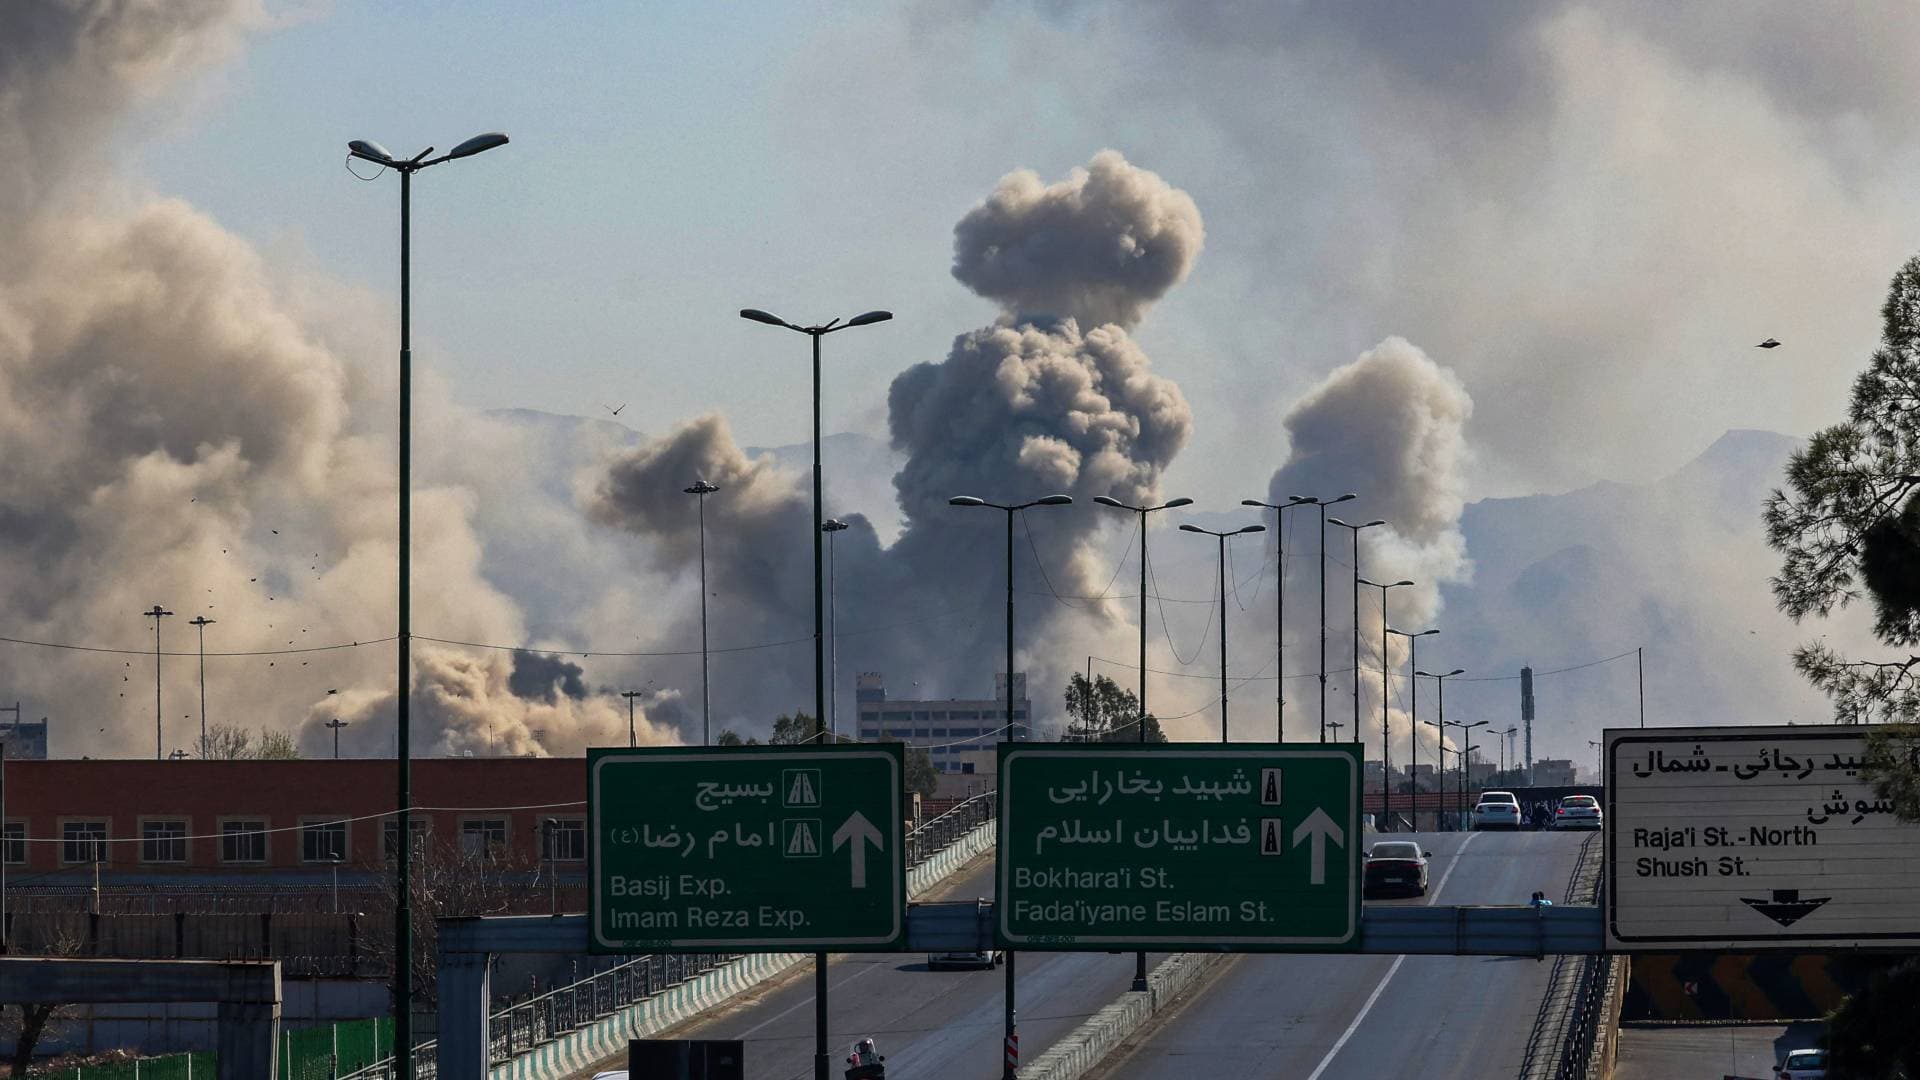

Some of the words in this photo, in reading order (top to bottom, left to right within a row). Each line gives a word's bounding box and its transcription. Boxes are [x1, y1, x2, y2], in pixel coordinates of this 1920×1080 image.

[695, 781, 774, 812] بسیج
[1048, 770, 1164, 806] بخارایی
[1171, 768, 1252, 802] شهید
[708, 821, 775, 859] امام
[1036, 819, 1123, 855] اسلام
[1133, 818, 1251, 851] فداییان
[1634, 827, 1696, 851] Raja'i
[1015, 867, 1131, 889] Bokhara'i
[1140, 868, 1175, 889] St.
[1636, 856, 1708, 877] Shush
[1718, 856, 1750, 877] St.
[610, 875, 670, 900] Basij
[679, 875, 732, 900] Exp.
[611, 907, 678, 929] Imam
[687, 907, 750, 928] Reza
[758, 906, 811, 931] Exp.
[1015, 899, 1147, 926] Fada'iyane
[1156, 900, 1231, 922] Eslam
[1240, 900, 1275, 922] St.
